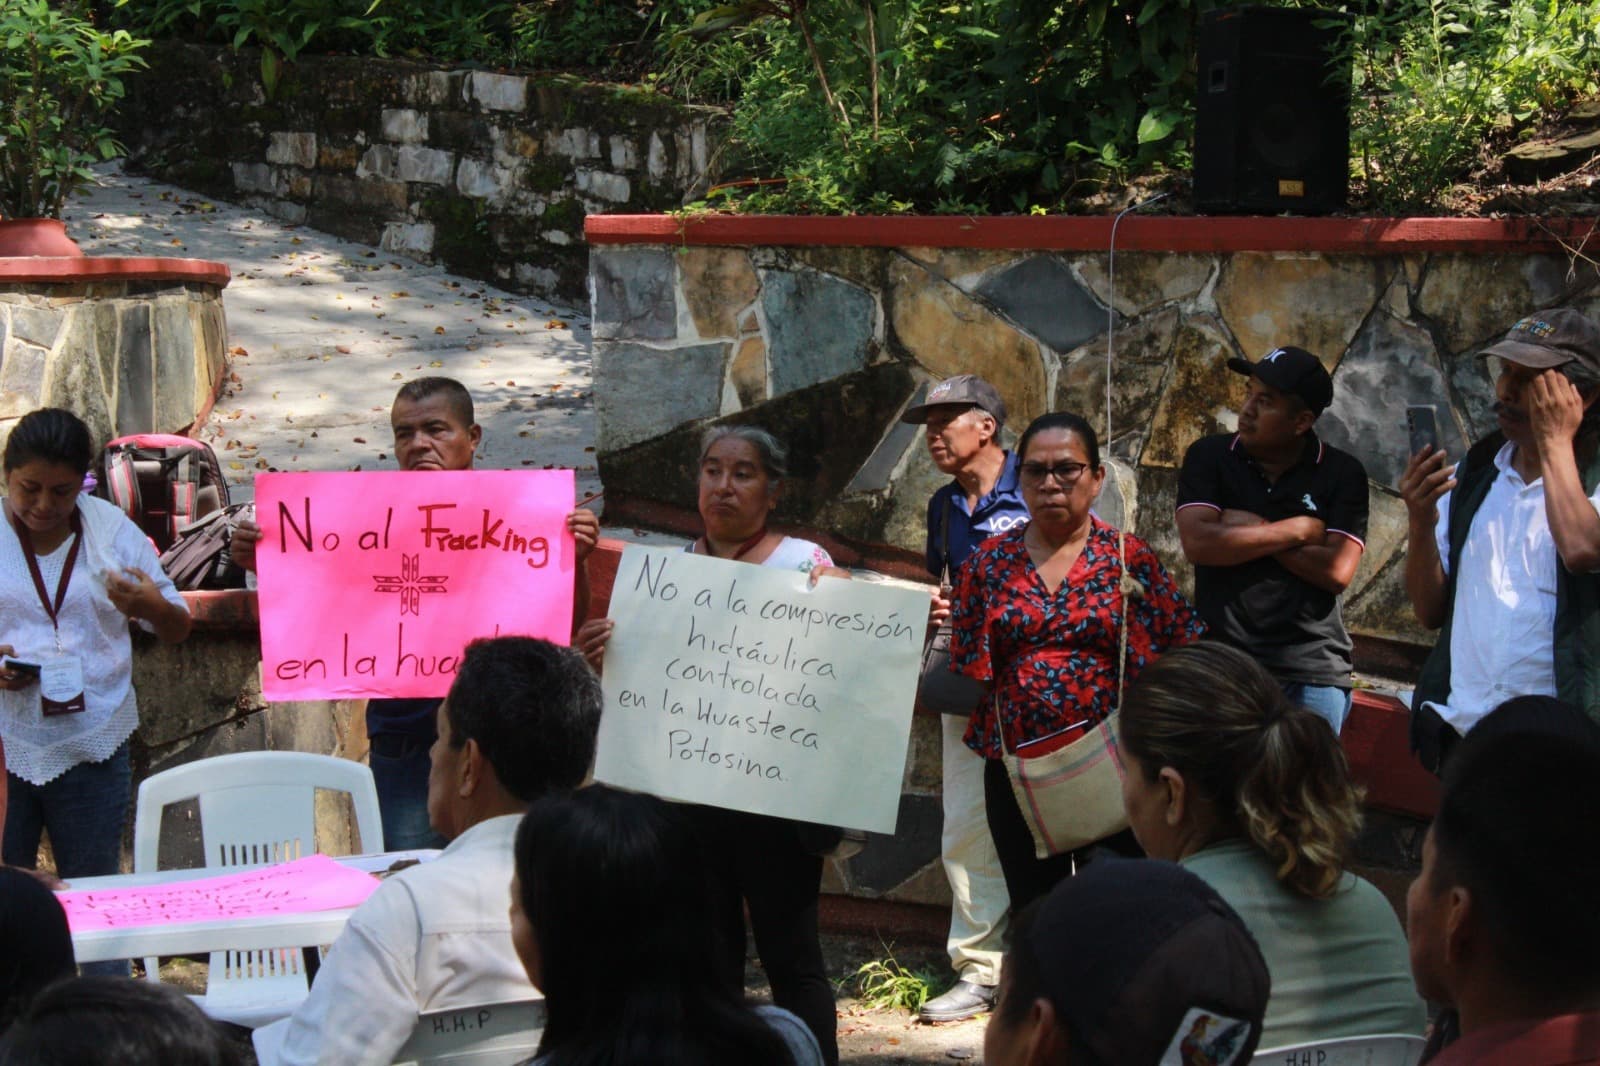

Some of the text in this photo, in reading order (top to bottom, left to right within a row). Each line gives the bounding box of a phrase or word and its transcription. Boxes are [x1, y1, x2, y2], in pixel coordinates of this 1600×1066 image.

[278, 497, 340, 553] No
[358, 507, 393, 550] al
[635, 554, 913, 641] No a la compresión
[276, 655, 326, 680] en
[343, 632, 376, 677] la
[688, 616, 836, 680] hidráulica
[666, 658, 821, 713] controlada
[619, 688, 818, 750] en la Huasteca
